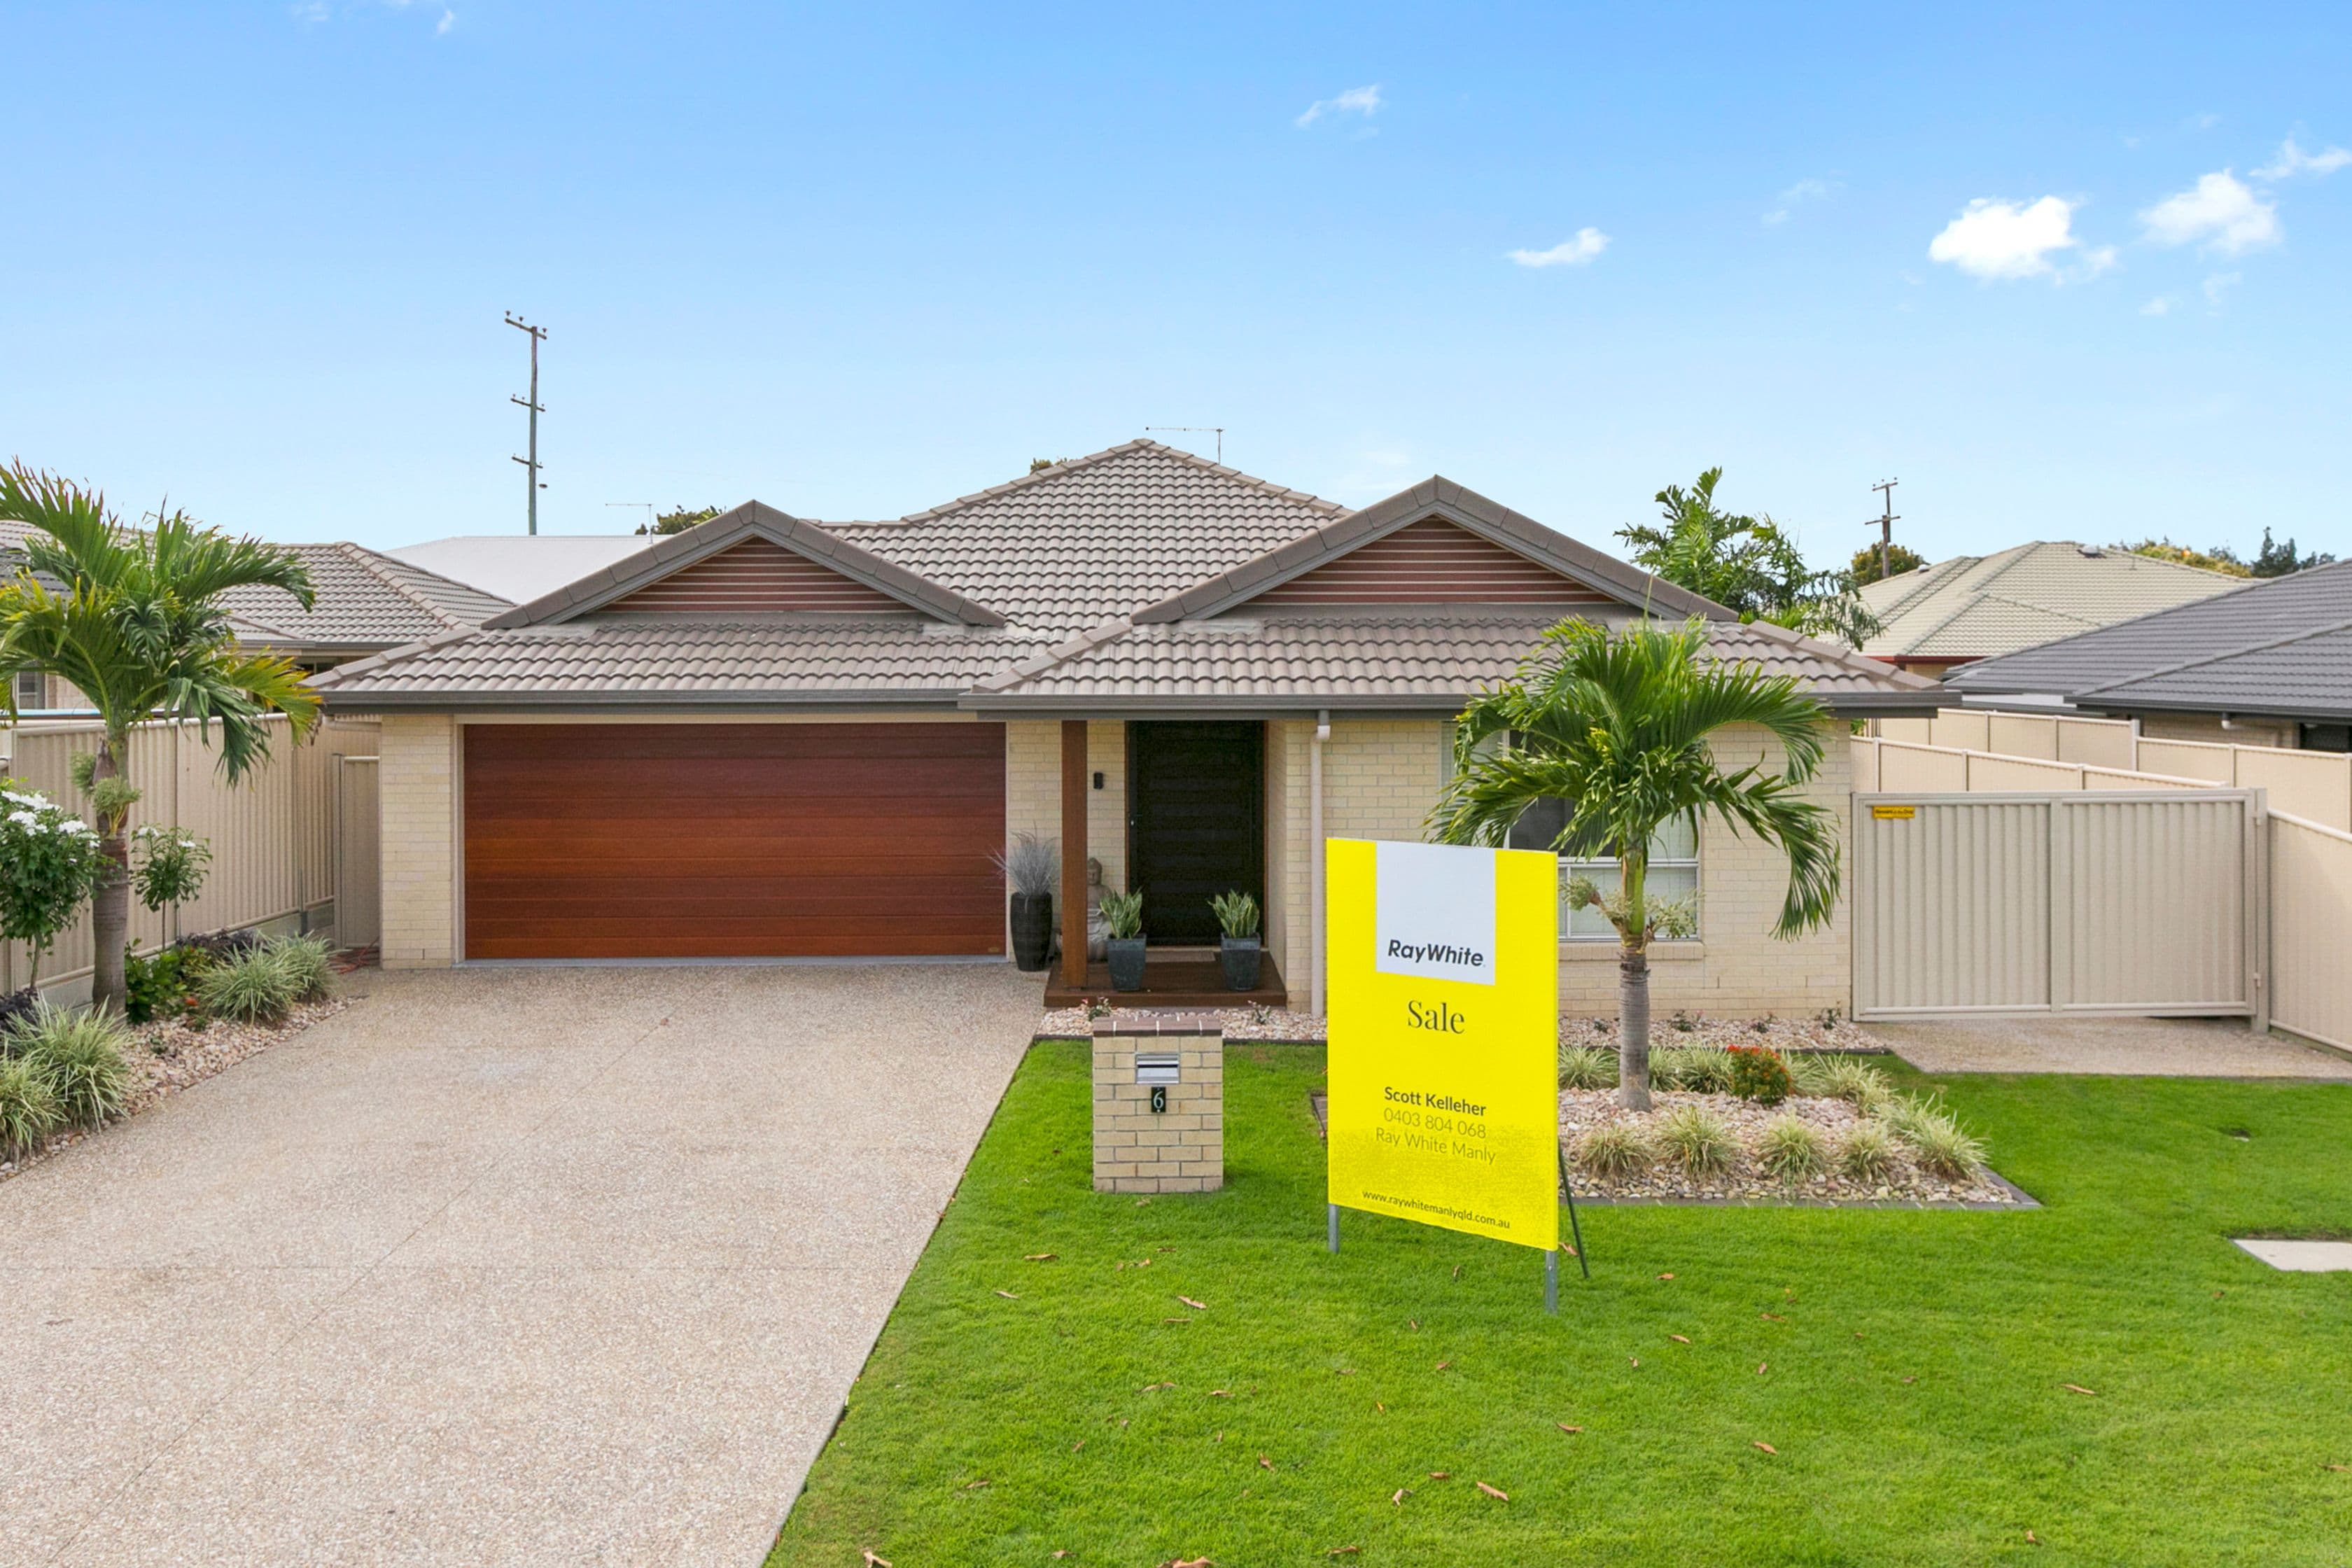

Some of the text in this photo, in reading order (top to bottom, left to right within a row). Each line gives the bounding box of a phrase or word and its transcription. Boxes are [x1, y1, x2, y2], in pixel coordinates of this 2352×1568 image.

[1407, 1000, 1465, 1034] Sale
[1154, 1091, 1163, 1110] 6
[1384, 1086, 1487, 1116] Scott Kelleher
[1383, 1107, 1487, 1139] 0403 804 068
[1376, 1127, 1497, 1165] Ray White Manly
[1362, 1191, 1511, 1229] www.raywhitemanlyqld.com.au
